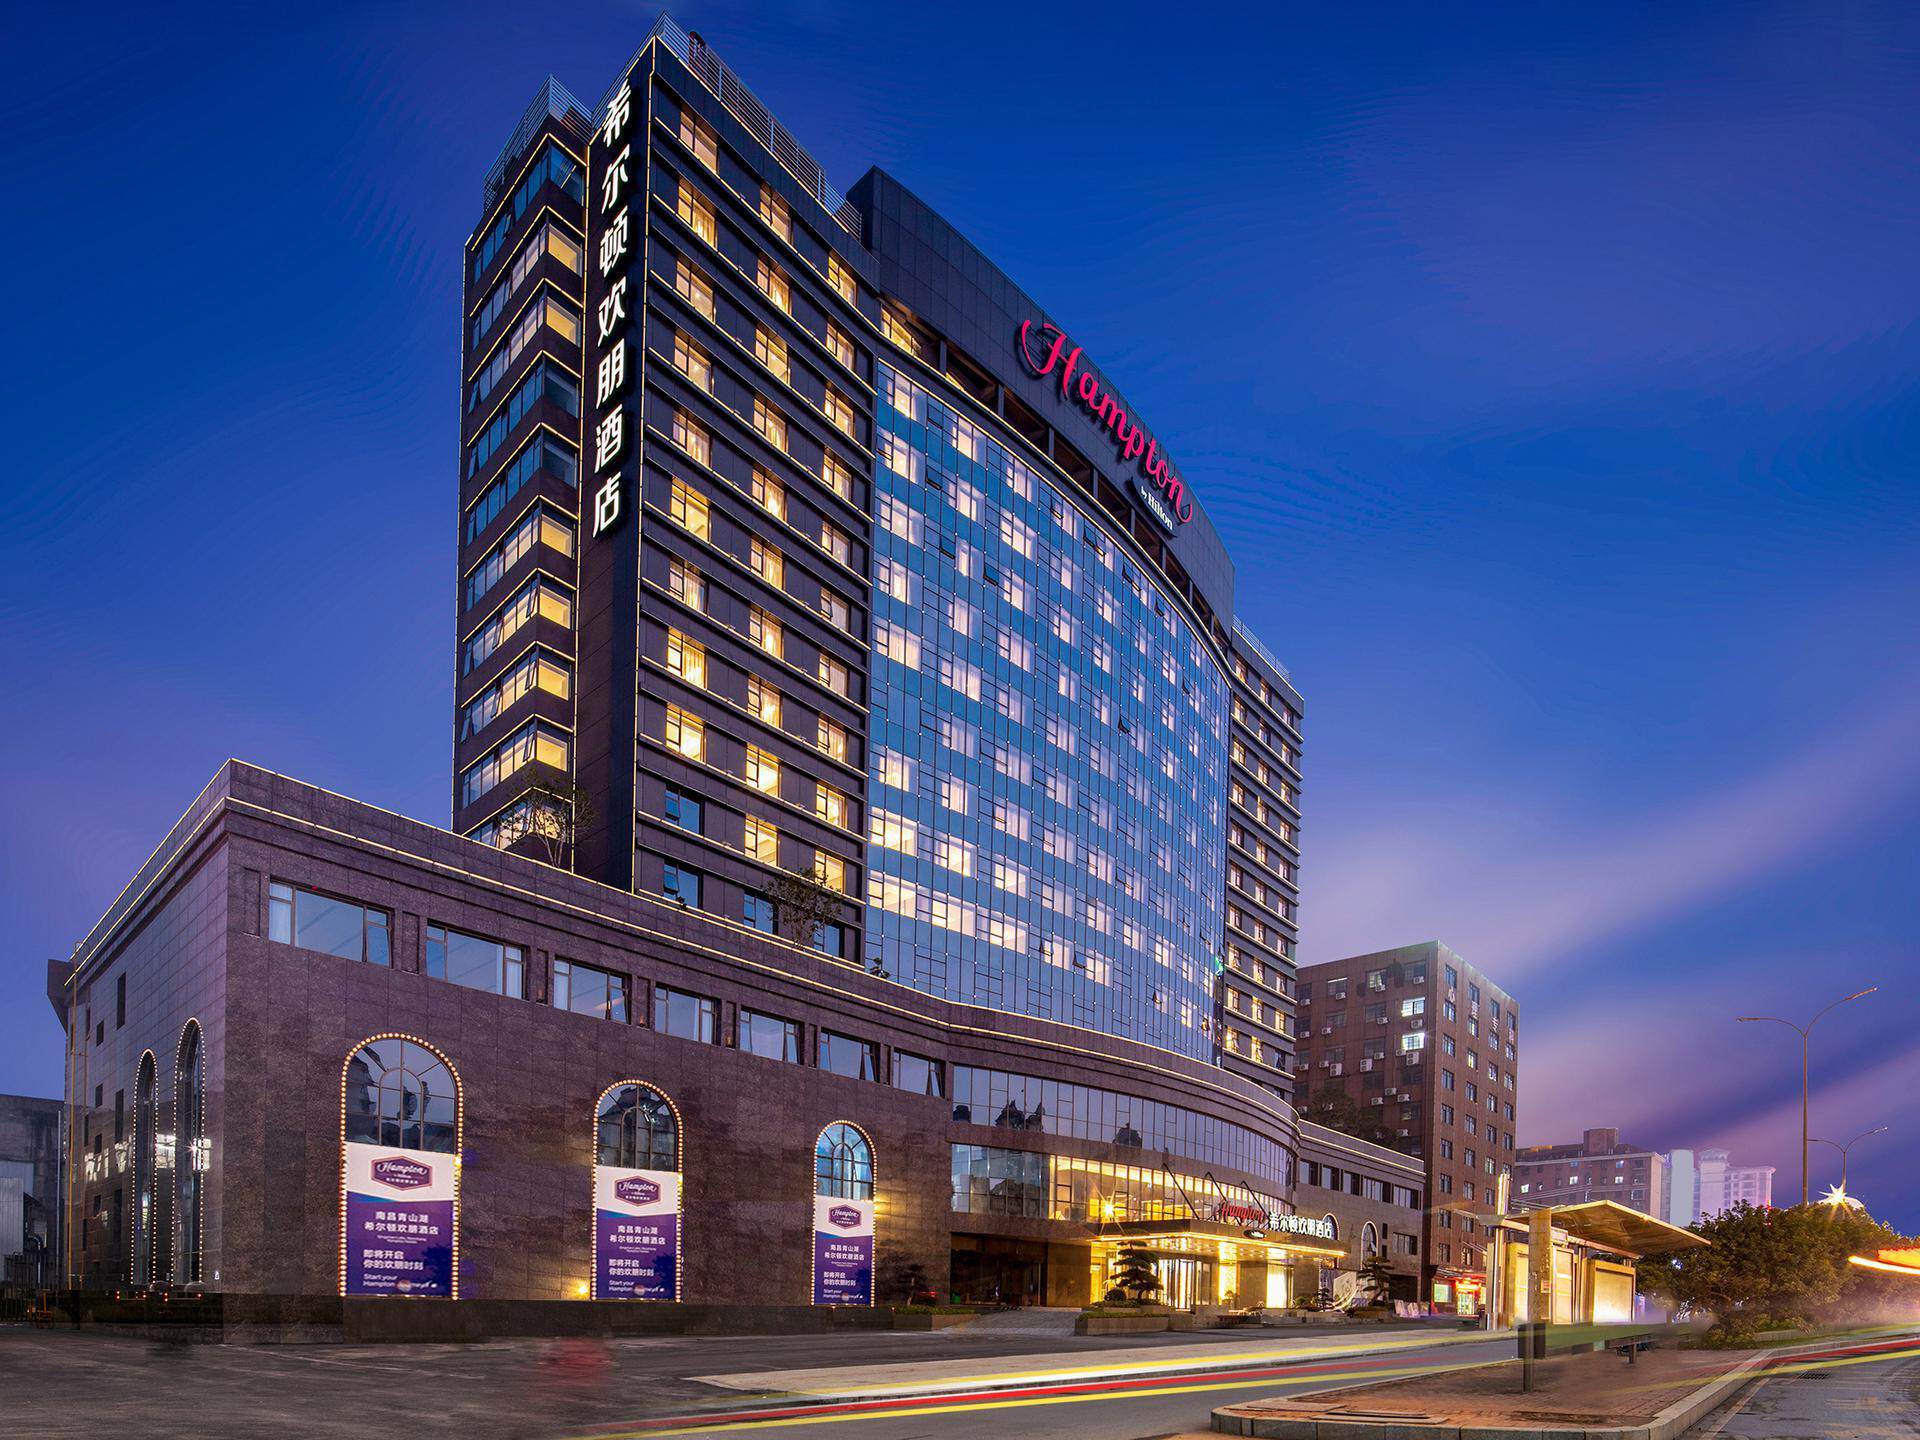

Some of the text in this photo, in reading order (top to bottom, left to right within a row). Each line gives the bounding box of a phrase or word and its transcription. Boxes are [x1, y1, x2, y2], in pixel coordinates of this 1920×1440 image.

[593, 79, 631, 537] 希尔顿欢朋酒店
[1020, 319, 1193, 523] Hampton
[1148, 492, 1173, 531] Hilton
[377, 1162, 427, 1175] Hampton
[1269, 1211, 1333, 1239] 希尔顿欢朋酒店
